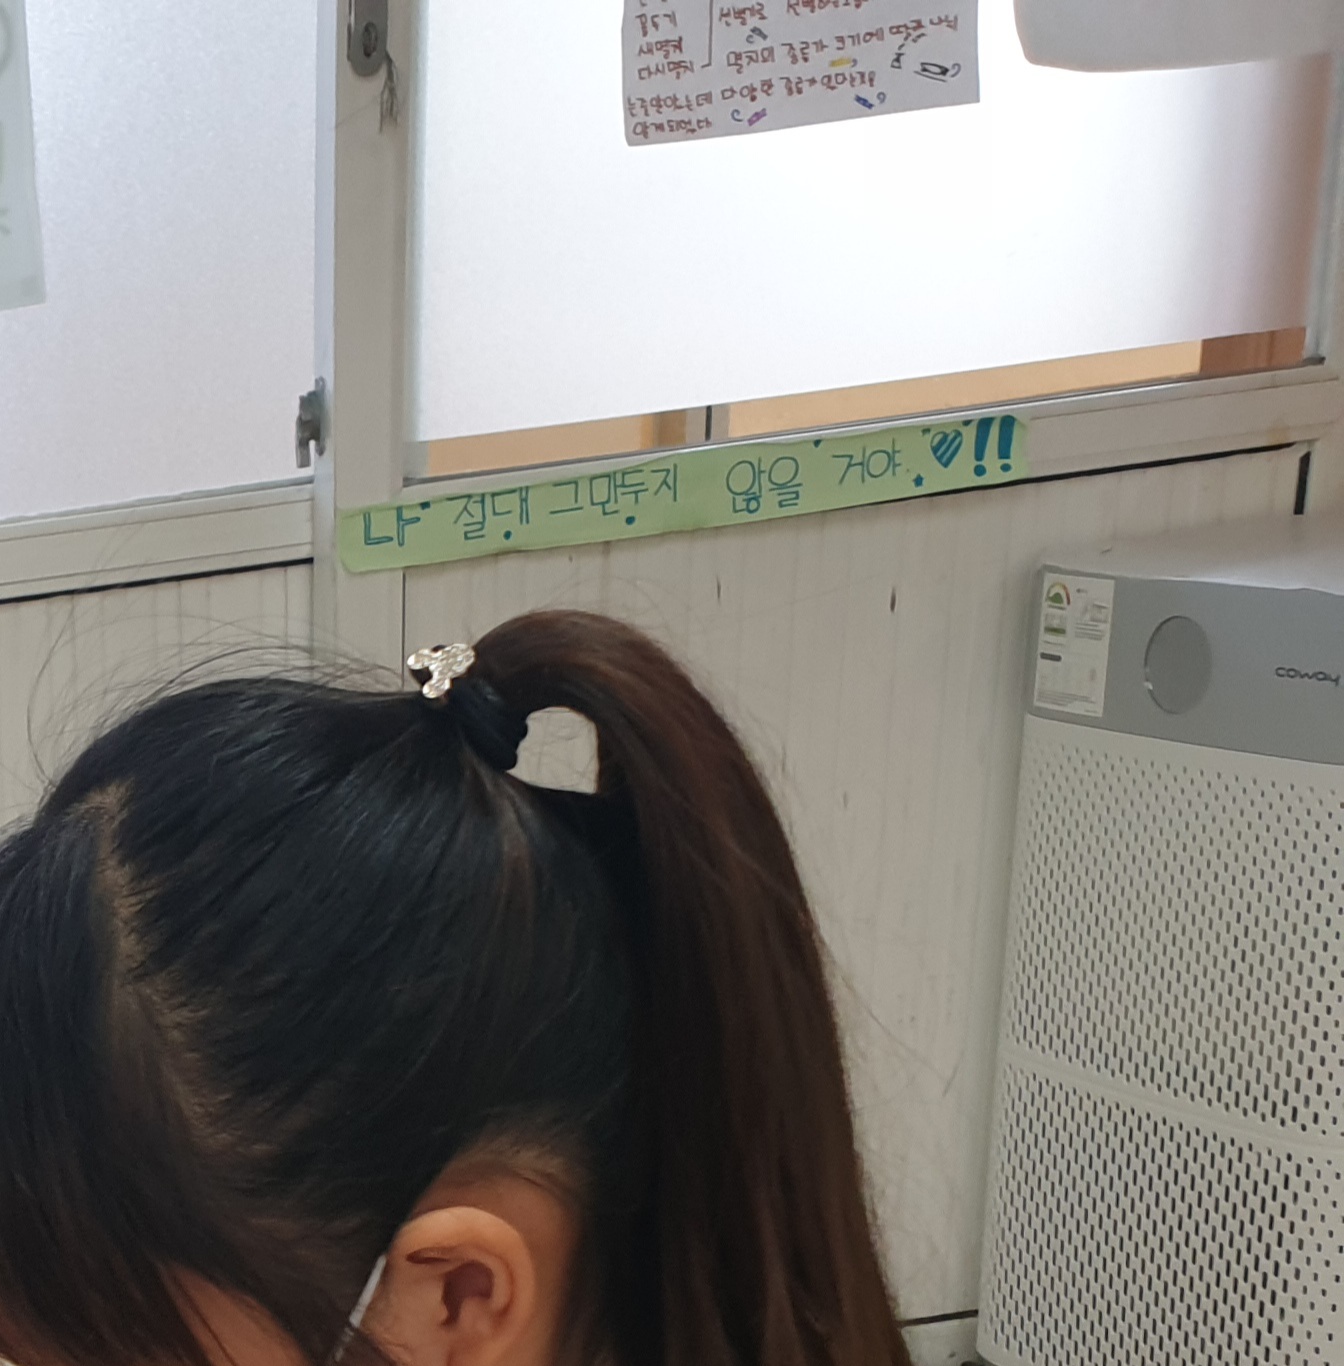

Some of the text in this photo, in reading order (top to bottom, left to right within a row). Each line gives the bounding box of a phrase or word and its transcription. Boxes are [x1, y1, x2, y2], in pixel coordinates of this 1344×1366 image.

[363, 505, 422, 547] 나
[446, 486, 530, 541] 절대
[549, 463, 678, 517] 그만두지
[726, 455, 804, 514] 않을
